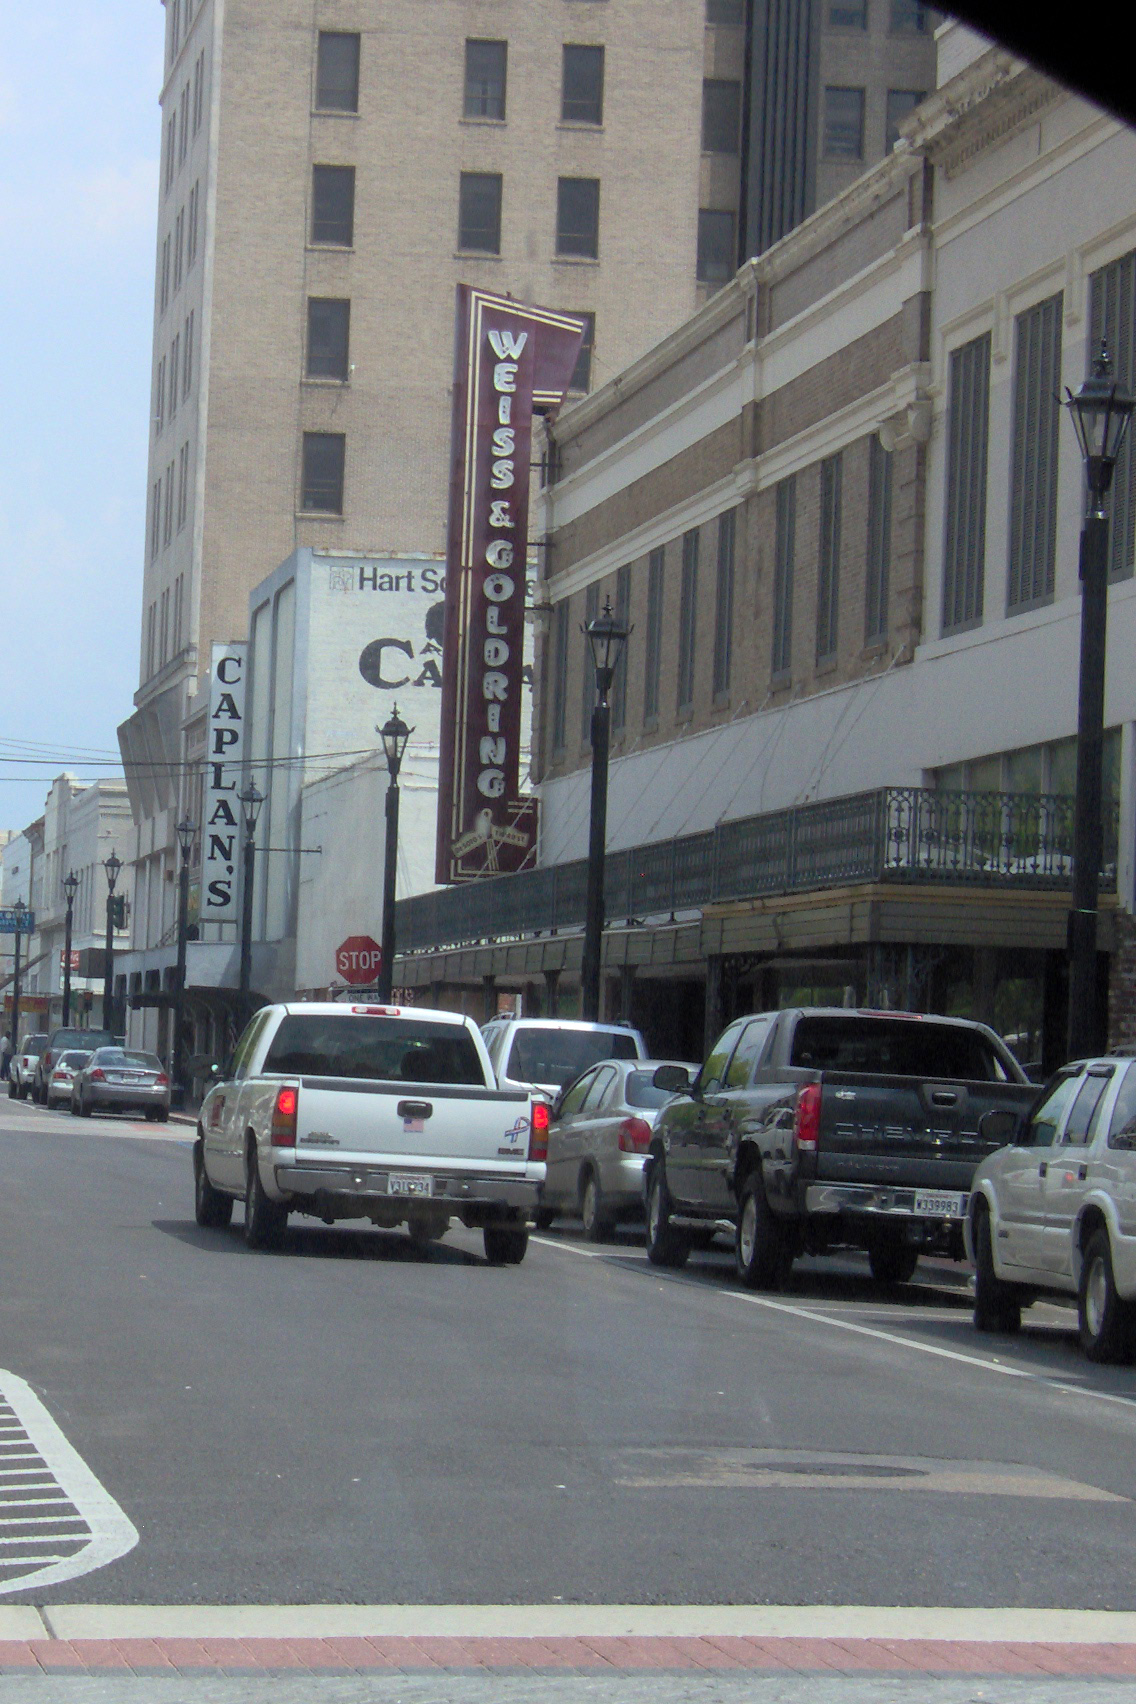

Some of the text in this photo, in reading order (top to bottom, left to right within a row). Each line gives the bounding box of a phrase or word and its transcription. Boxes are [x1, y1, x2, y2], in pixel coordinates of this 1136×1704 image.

[359, 566, 415, 592] Hart
[477, 330, 528, 798] WEISS & GOLDRING
[206, 656, 243, 908] CAPLAN'S
[339, 951, 382, 970] STOP
